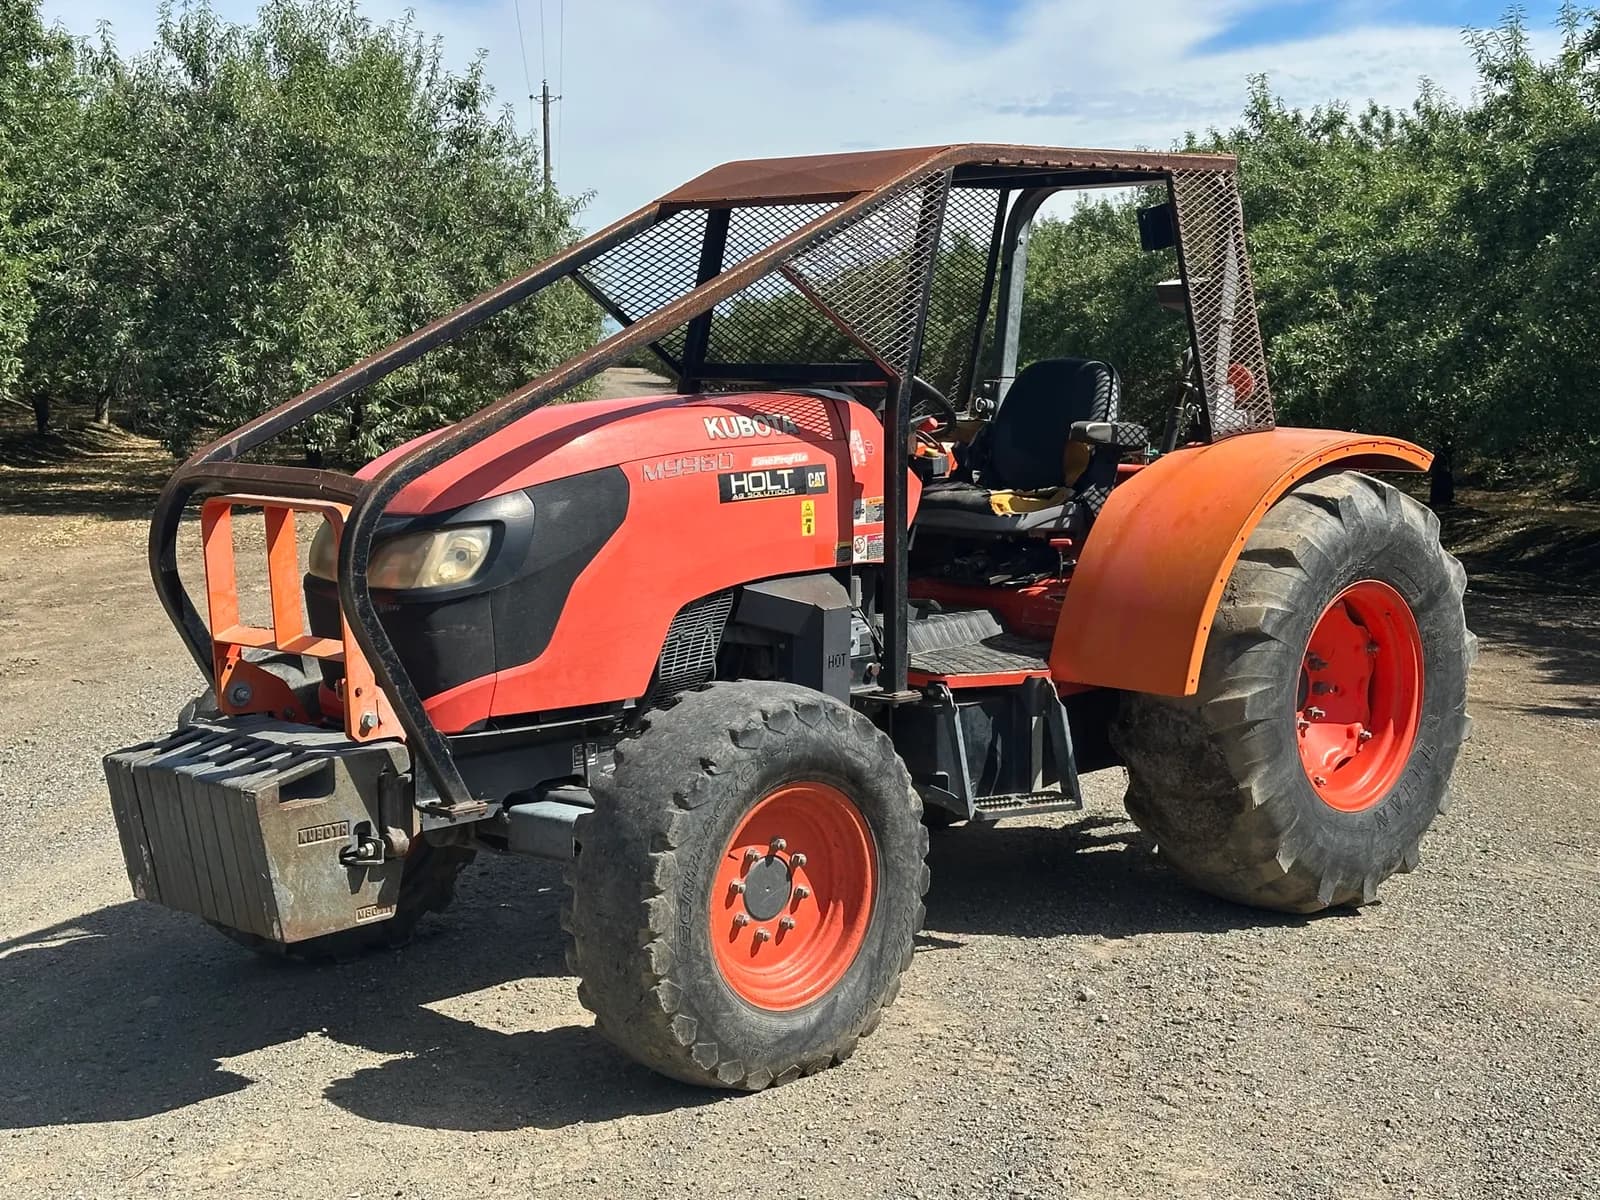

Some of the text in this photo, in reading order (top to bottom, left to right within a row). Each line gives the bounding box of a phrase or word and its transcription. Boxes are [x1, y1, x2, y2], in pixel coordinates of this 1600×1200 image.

[704, 415, 800, 440] KUBOTA
[642, 452, 734, 482] M9960
[730, 469, 794, 493] HOLT
[807, 472, 826, 488] CAT
[747, 488, 796, 498] SOLUTIONS
[828, 653, 846, 668] HOT
[298, 823, 348, 846] KUBOTA
